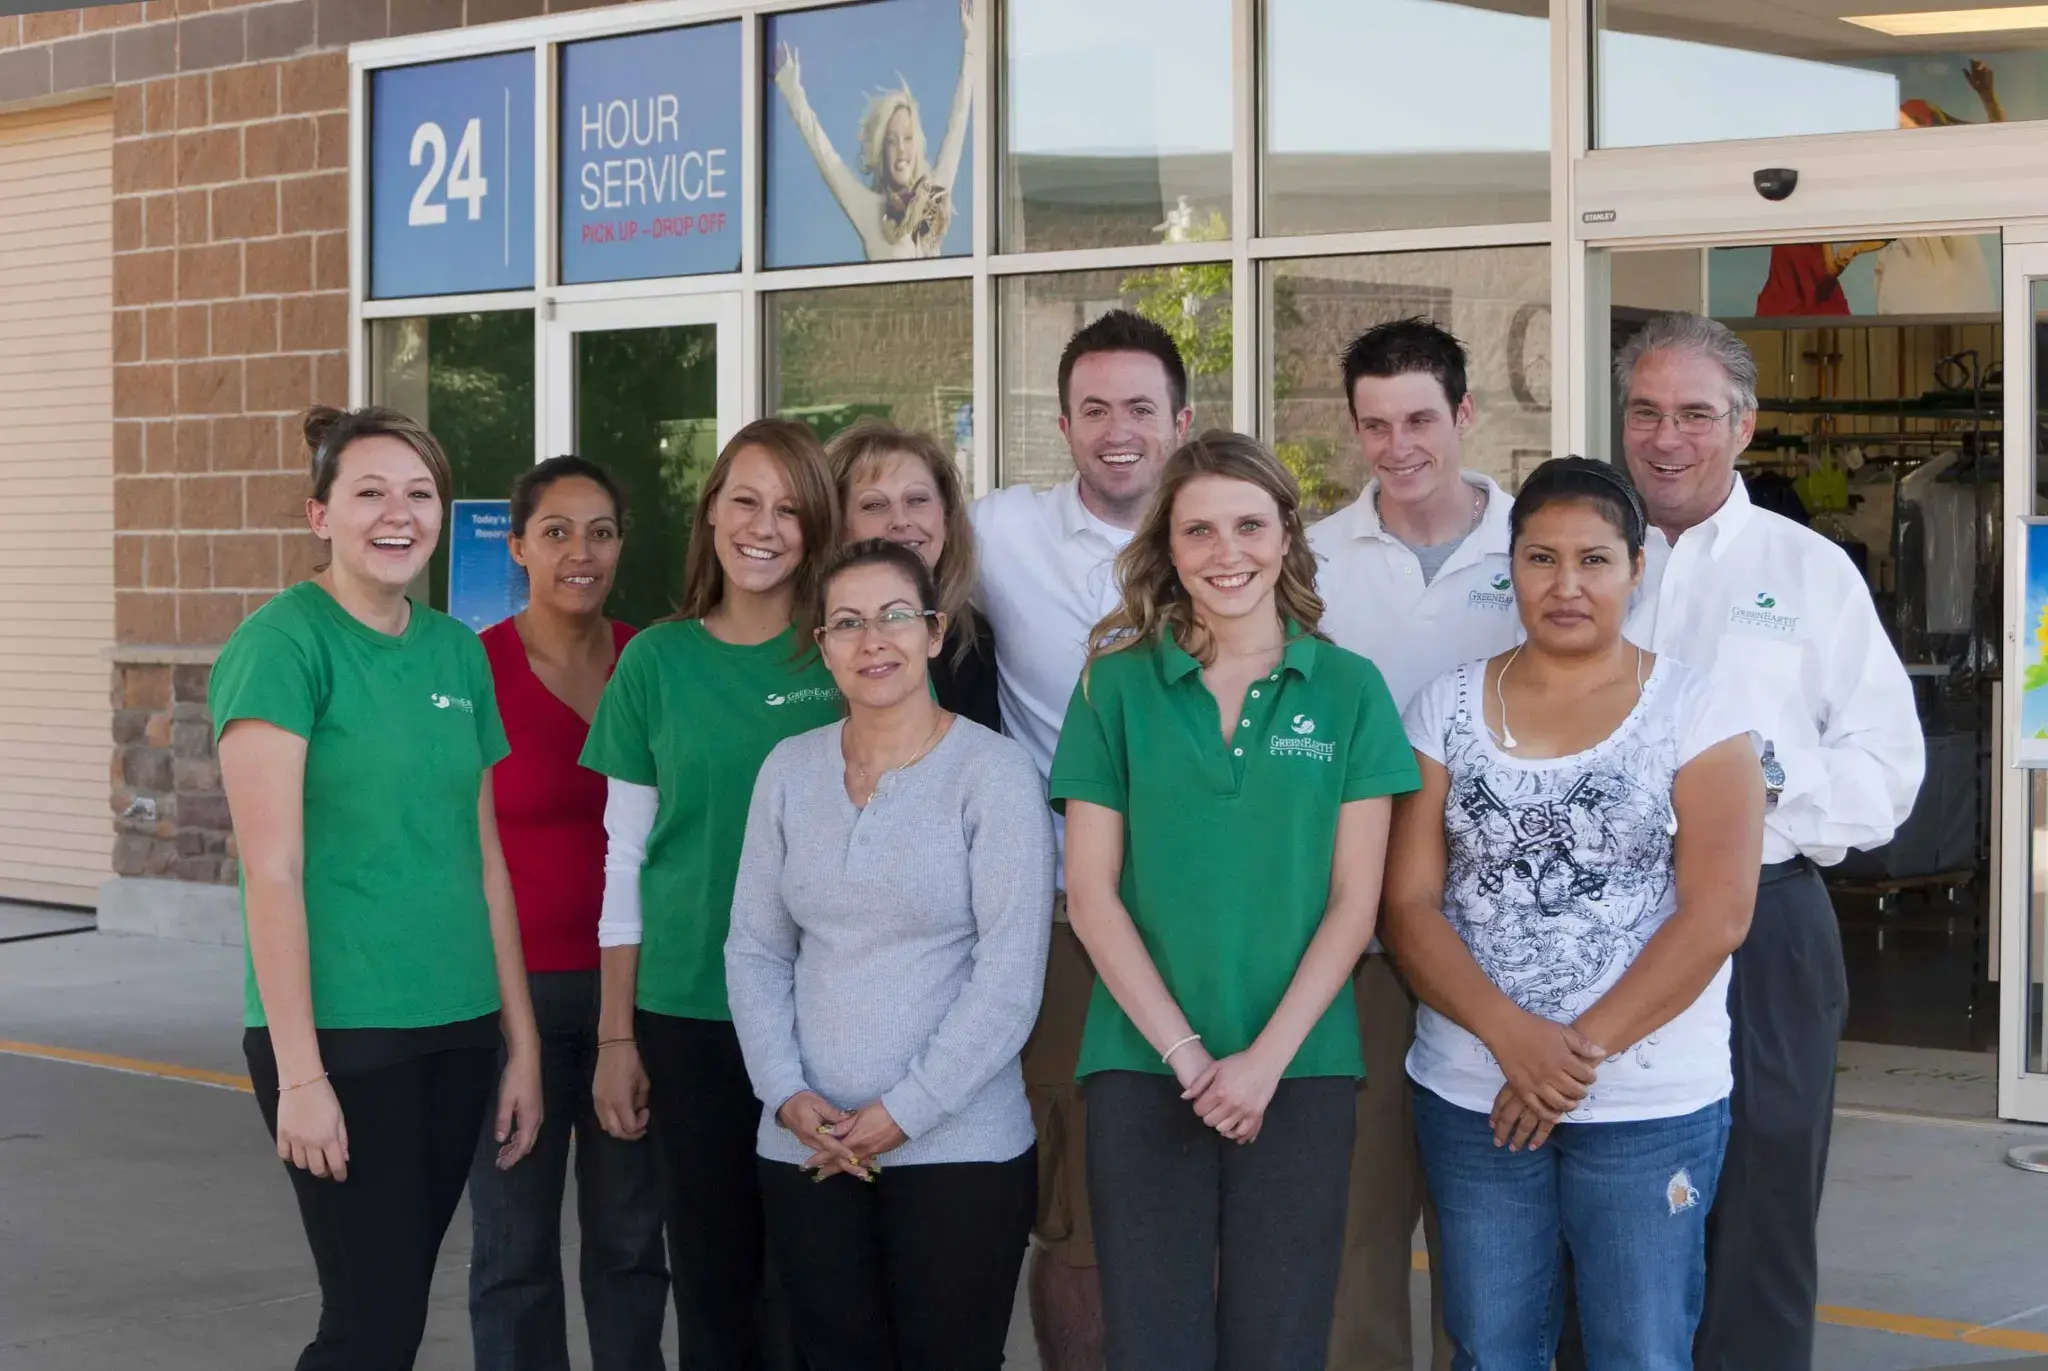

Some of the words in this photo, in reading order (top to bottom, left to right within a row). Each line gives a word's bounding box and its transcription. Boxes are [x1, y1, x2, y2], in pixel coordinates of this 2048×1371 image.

[582, 94, 679, 151] HOUR
[408, 117, 488, 226] 24
[581, 149, 727, 211] SERVICE
[582, 221, 614, 244] PICK
[618, 220, 638, 241] UP
[698, 212, 726, 235] OFF
[1585, 212, 1614, 221] STANLEY
[472, 514, 507, 526] Today's
[1270, 749, 1332, 762] CLEANERS
